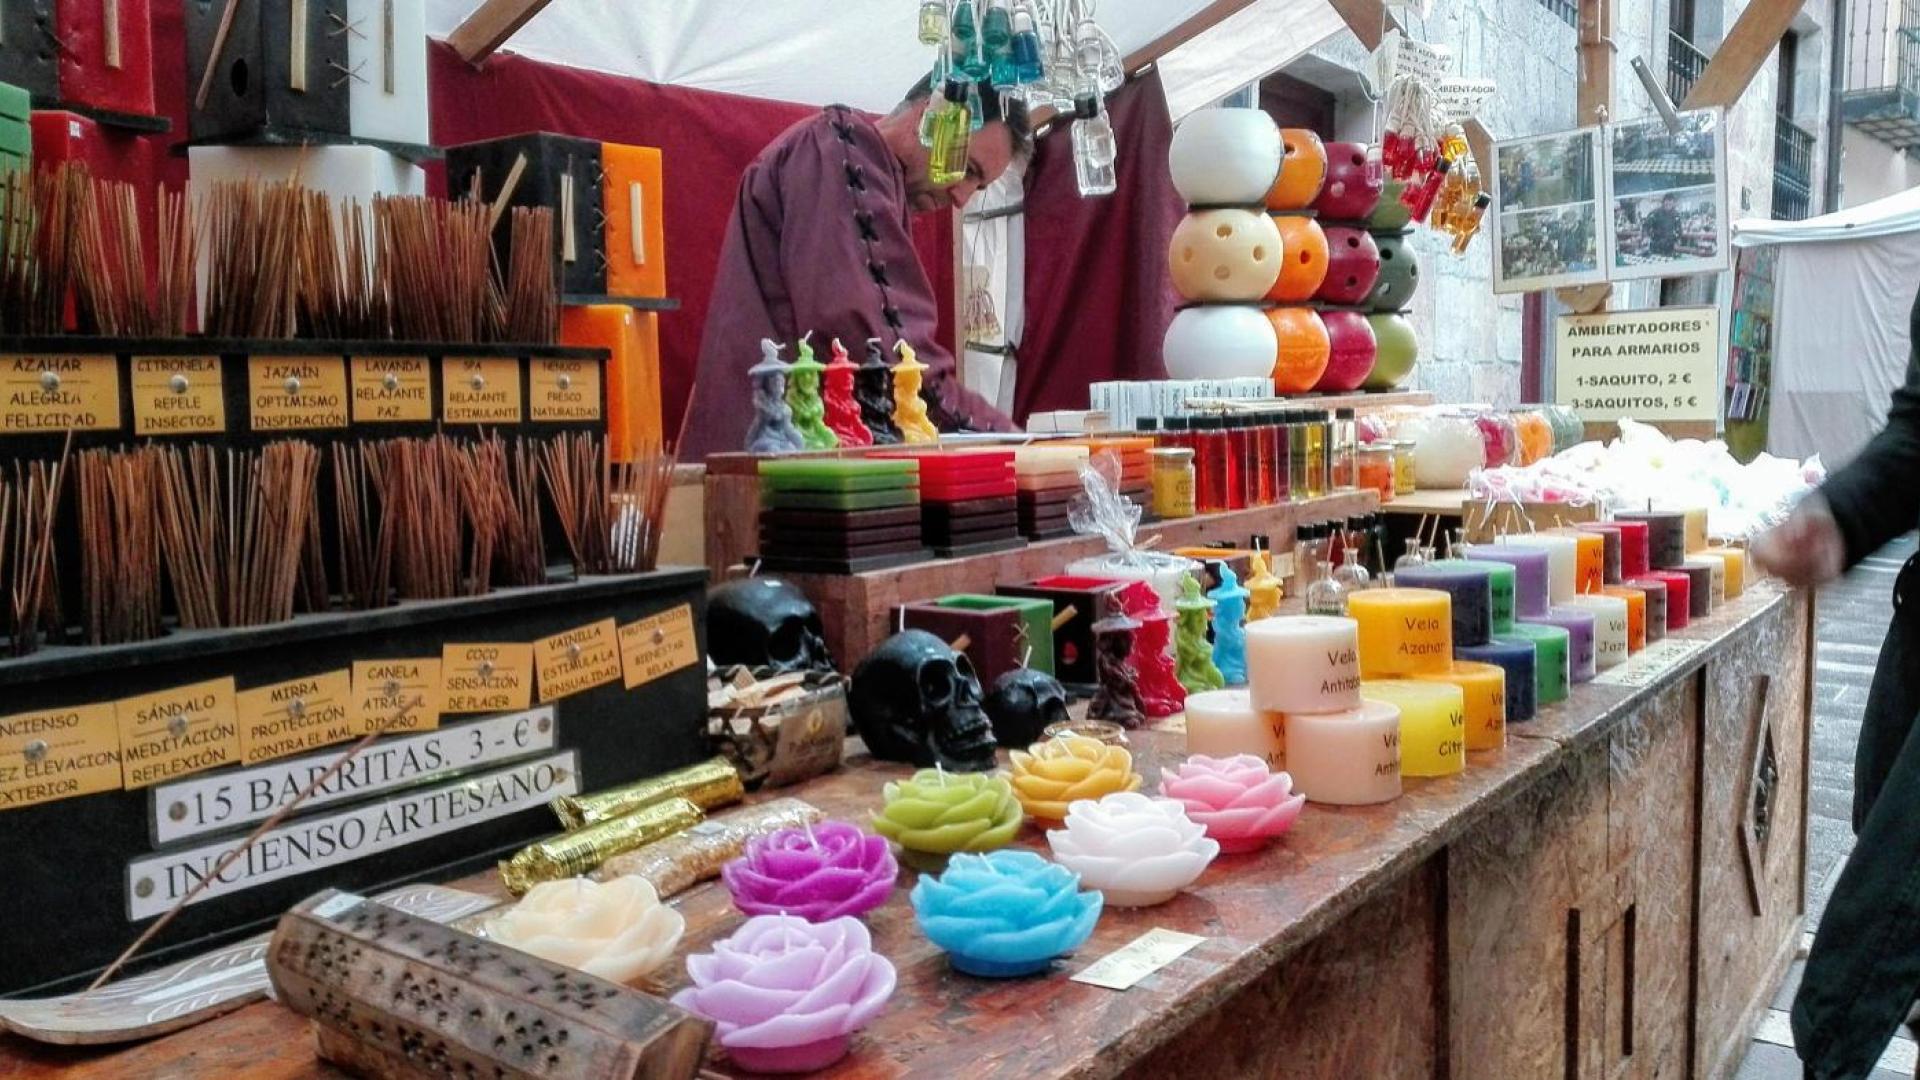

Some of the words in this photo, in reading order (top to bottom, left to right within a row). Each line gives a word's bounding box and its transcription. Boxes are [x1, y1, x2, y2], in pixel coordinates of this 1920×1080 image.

[1567, 320, 1702, 338] AMBIENTADORES
[1572, 346, 1613, 359] PARA
[1616, 342, 1701, 356] ARMARIOS
[13, 358, 83, 372] AZAHAR
[137, 359, 216, 373] CITRONELA
[263, 362, 320, 379] JAZMÍN
[365, 359, 422, 373] LAVANDA
[1576, 374, 1663, 388] 1-SAQUITO,
[1668, 373, 1677, 384] 2
[1682, 372, 1692, 384] €
[356, 386, 426, 401] RELAJANTE
[449, 391, 507, 403] RELAJANTE
[547, 391, 582, 403] FRESCO
[153, 396, 201, 410] REPELE
[256, 395, 339, 409] OPTIMISMO
[1572, 396, 1669, 411] 3-SAQUITOS,
[1673, 396, 1683, 407] 5
[1687, 396, 1698, 407] €
[254, 411, 347, 428] INSPIRACIÓN
[377, 406, 401, 418] PAZ
[447, 407, 518, 419] ESTIMULANTE
[533, 406, 599, 417] NATURALIDAD
[5, 412, 97, 429] FELICIDAD
[143, 415, 216, 430] INSECTOS
[1405, 617, 1440, 631] Vela
[549, 626, 601, 651] VAINILLA
[466, 647, 499, 661] COCO
[1327, 647, 1358, 667] Vela
[367, 664, 420, 680] CANELA
[542, 653, 599, 681] ESTIMULA
[601, 650, 615, 662] LA
[541, 666, 619, 699] SENSUALIDAD
[271, 681, 319, 702] MIRRA
[136, 694, 216, 726] SÁNDALO
[448, 696, 465, 710] DE
[467, 695, 510, 709] PLACER
[251, 704, 346, 739] PROTECCIÓN
[126, 724, 235, 764] MEDITACIÓN
[248, 737, 305, 761] CONTRA
[307, 733, 321, 747] EL
[327, 724, 351, 742] MAL
[132, 748, 226, 784] REFLEXIÓN
[194, 785, 233, 826] 15
[247, 738, 451, 814] BARRITAS.
[469, 729, 485, 761] 3
[512, 718, 531, 748] €
[164, 818, 367, 900] INCIENSO
[375, 763, 556, 843] ARTESANO
